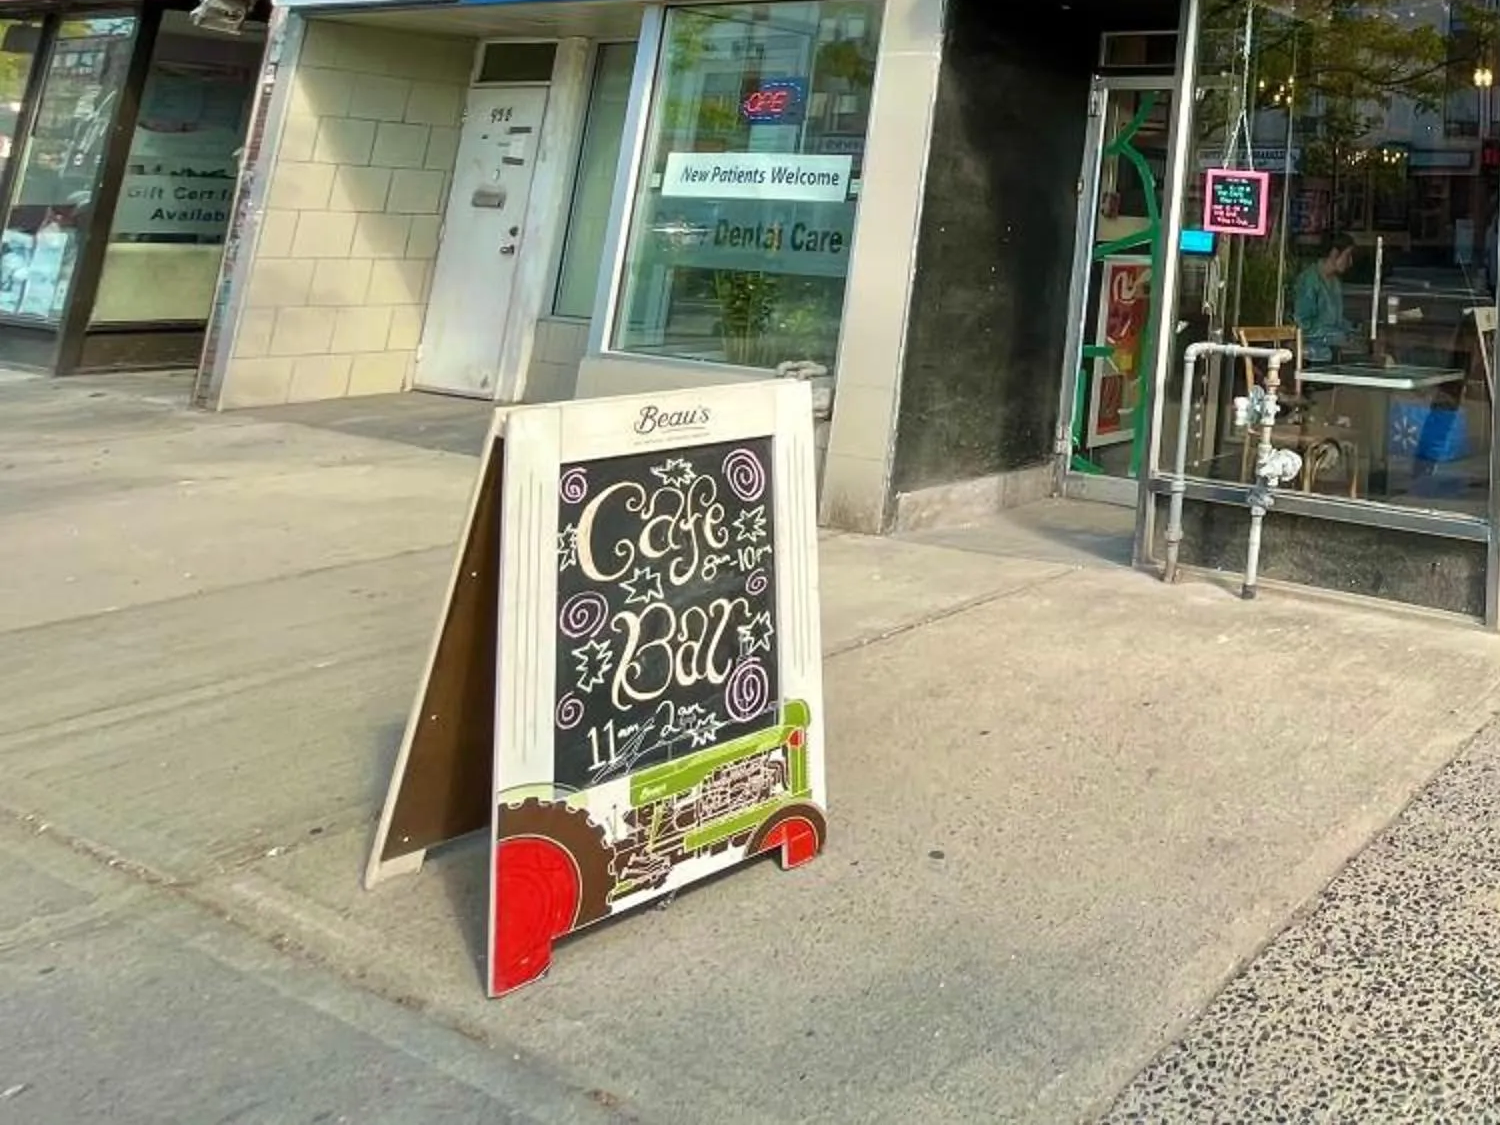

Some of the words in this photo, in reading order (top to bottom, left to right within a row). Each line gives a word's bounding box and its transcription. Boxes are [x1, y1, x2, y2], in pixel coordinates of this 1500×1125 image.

[746, 90, 790, 112] OPE
[680, 166, 708, 184] New
[710, 165, 766, 184] Patients
[770, 166, 840, 187] Welcome
[713, 219, 783, 252] Dental
[790, 221, 843, 254] Care
[633, 404, 712, 435] Beau's
[576, 475, 728, 585] Cafe
[611, 597, 752, 710] Bar
